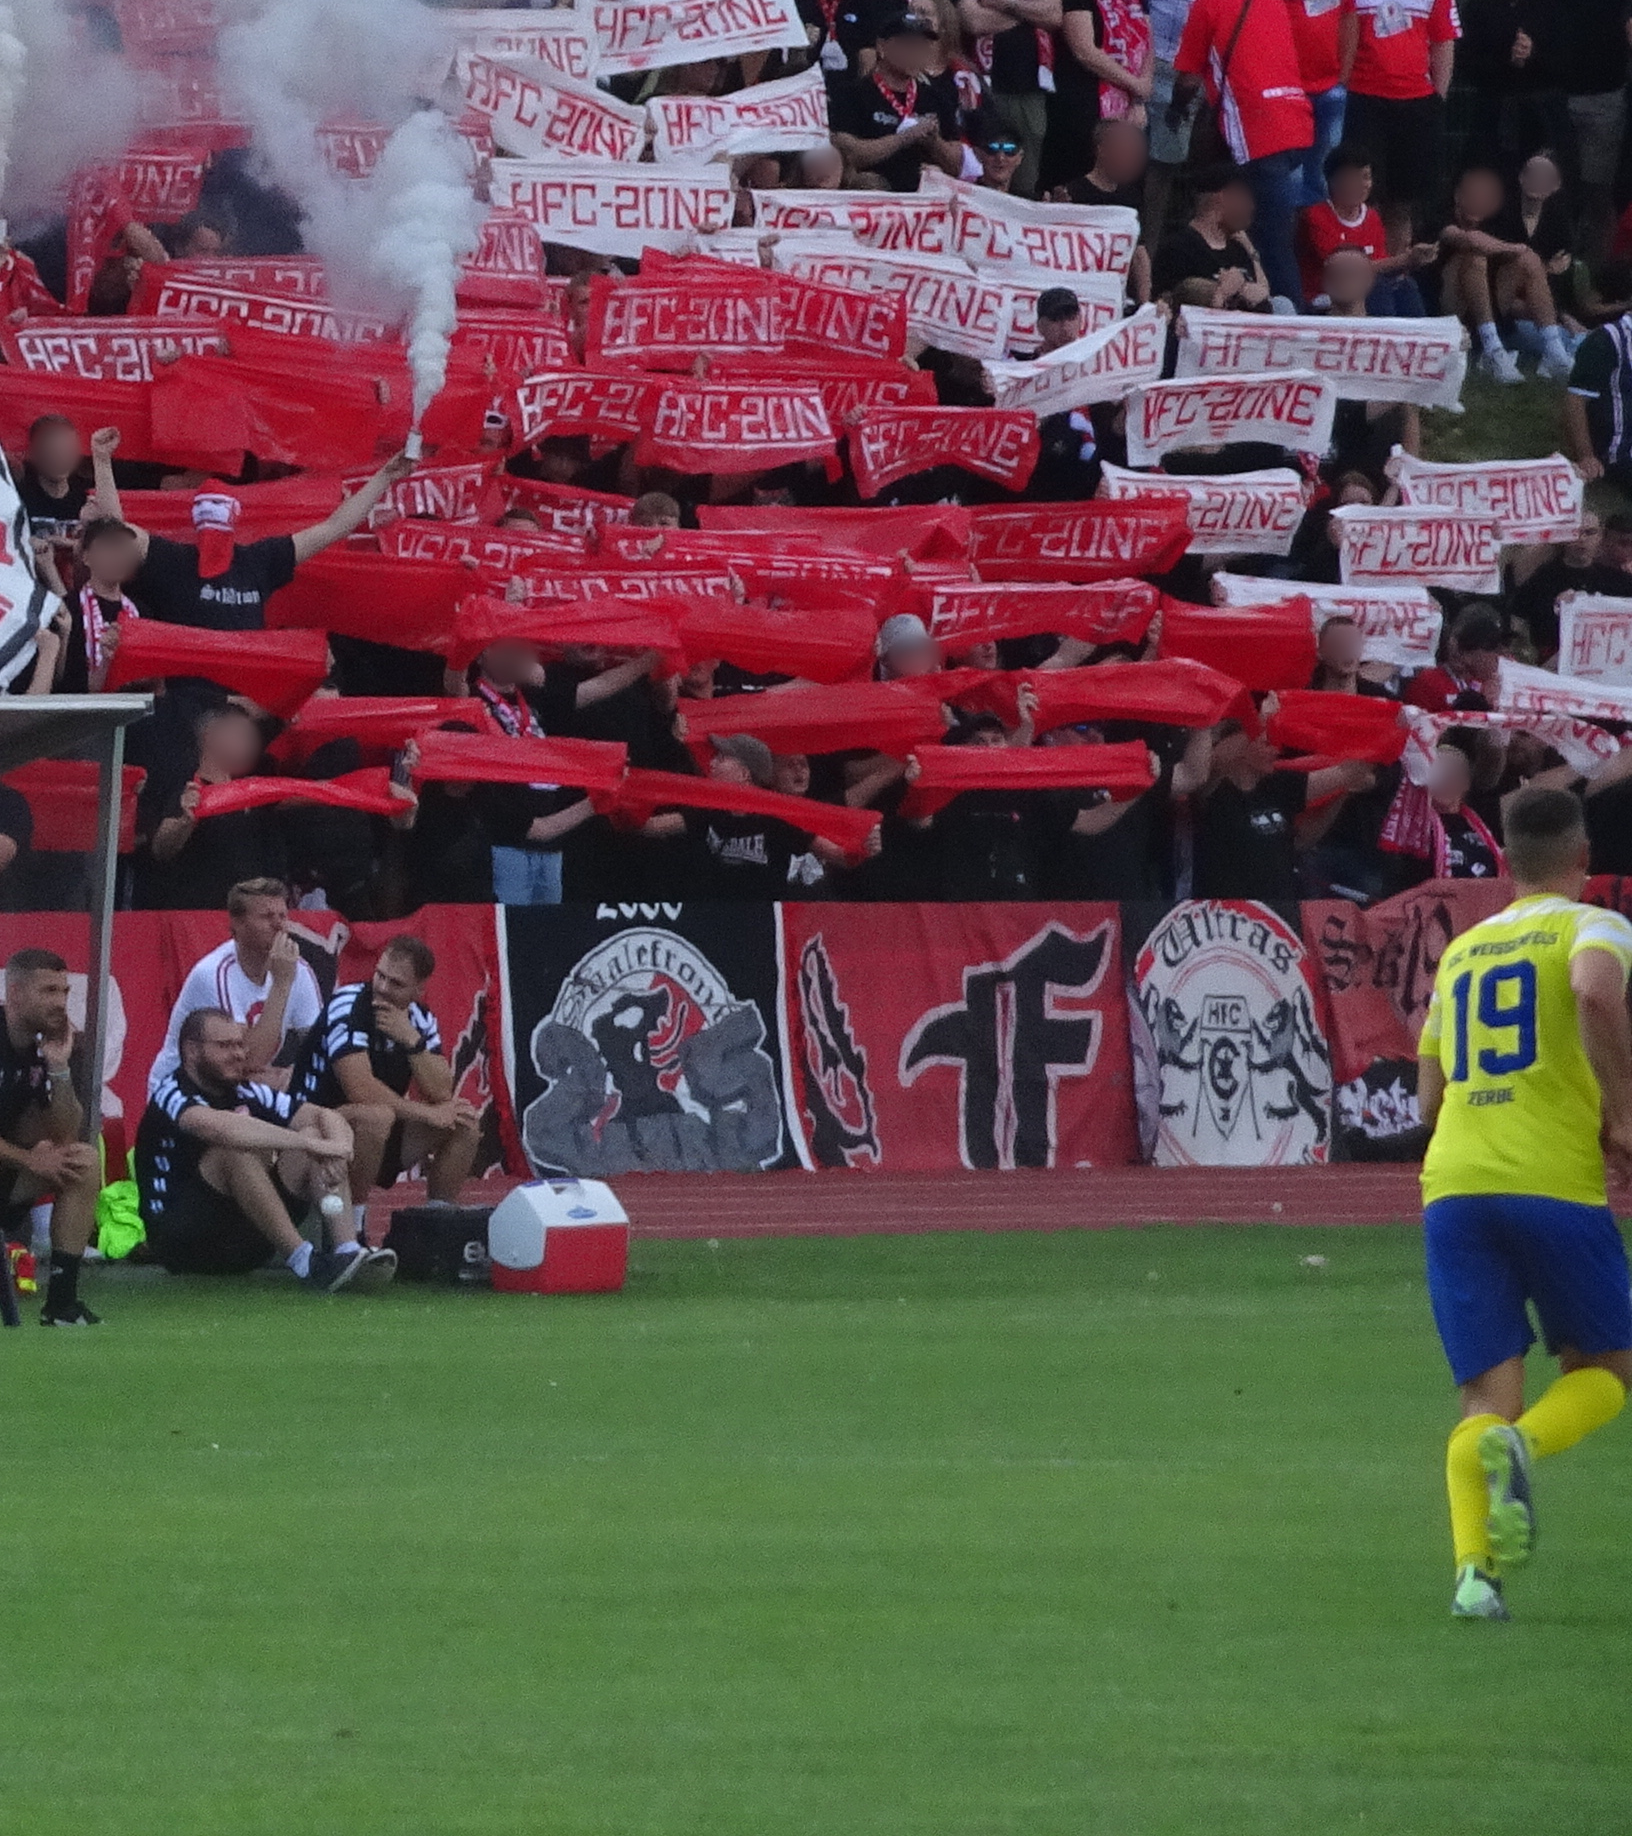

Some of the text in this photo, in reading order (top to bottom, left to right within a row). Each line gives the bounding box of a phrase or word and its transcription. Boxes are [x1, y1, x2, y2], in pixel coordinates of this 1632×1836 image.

[465, 61, 635, 160] HFC-ZONE
[512, 183, 730, 229] HFC-ZONE
[603, 293, 786, 344] HFC-ZONE
[1199, 330, 1450, 380] HFC-ZONE
[657, 393, 831, 442] HFC-ZON
[1145, 384, 1322, 437] HFC-ZONE
[1154, 904, 1296, 974] Ultras
[1208, 1002, 1242, 1025] HFC
[1450, 959, 1537, 1082] 19
